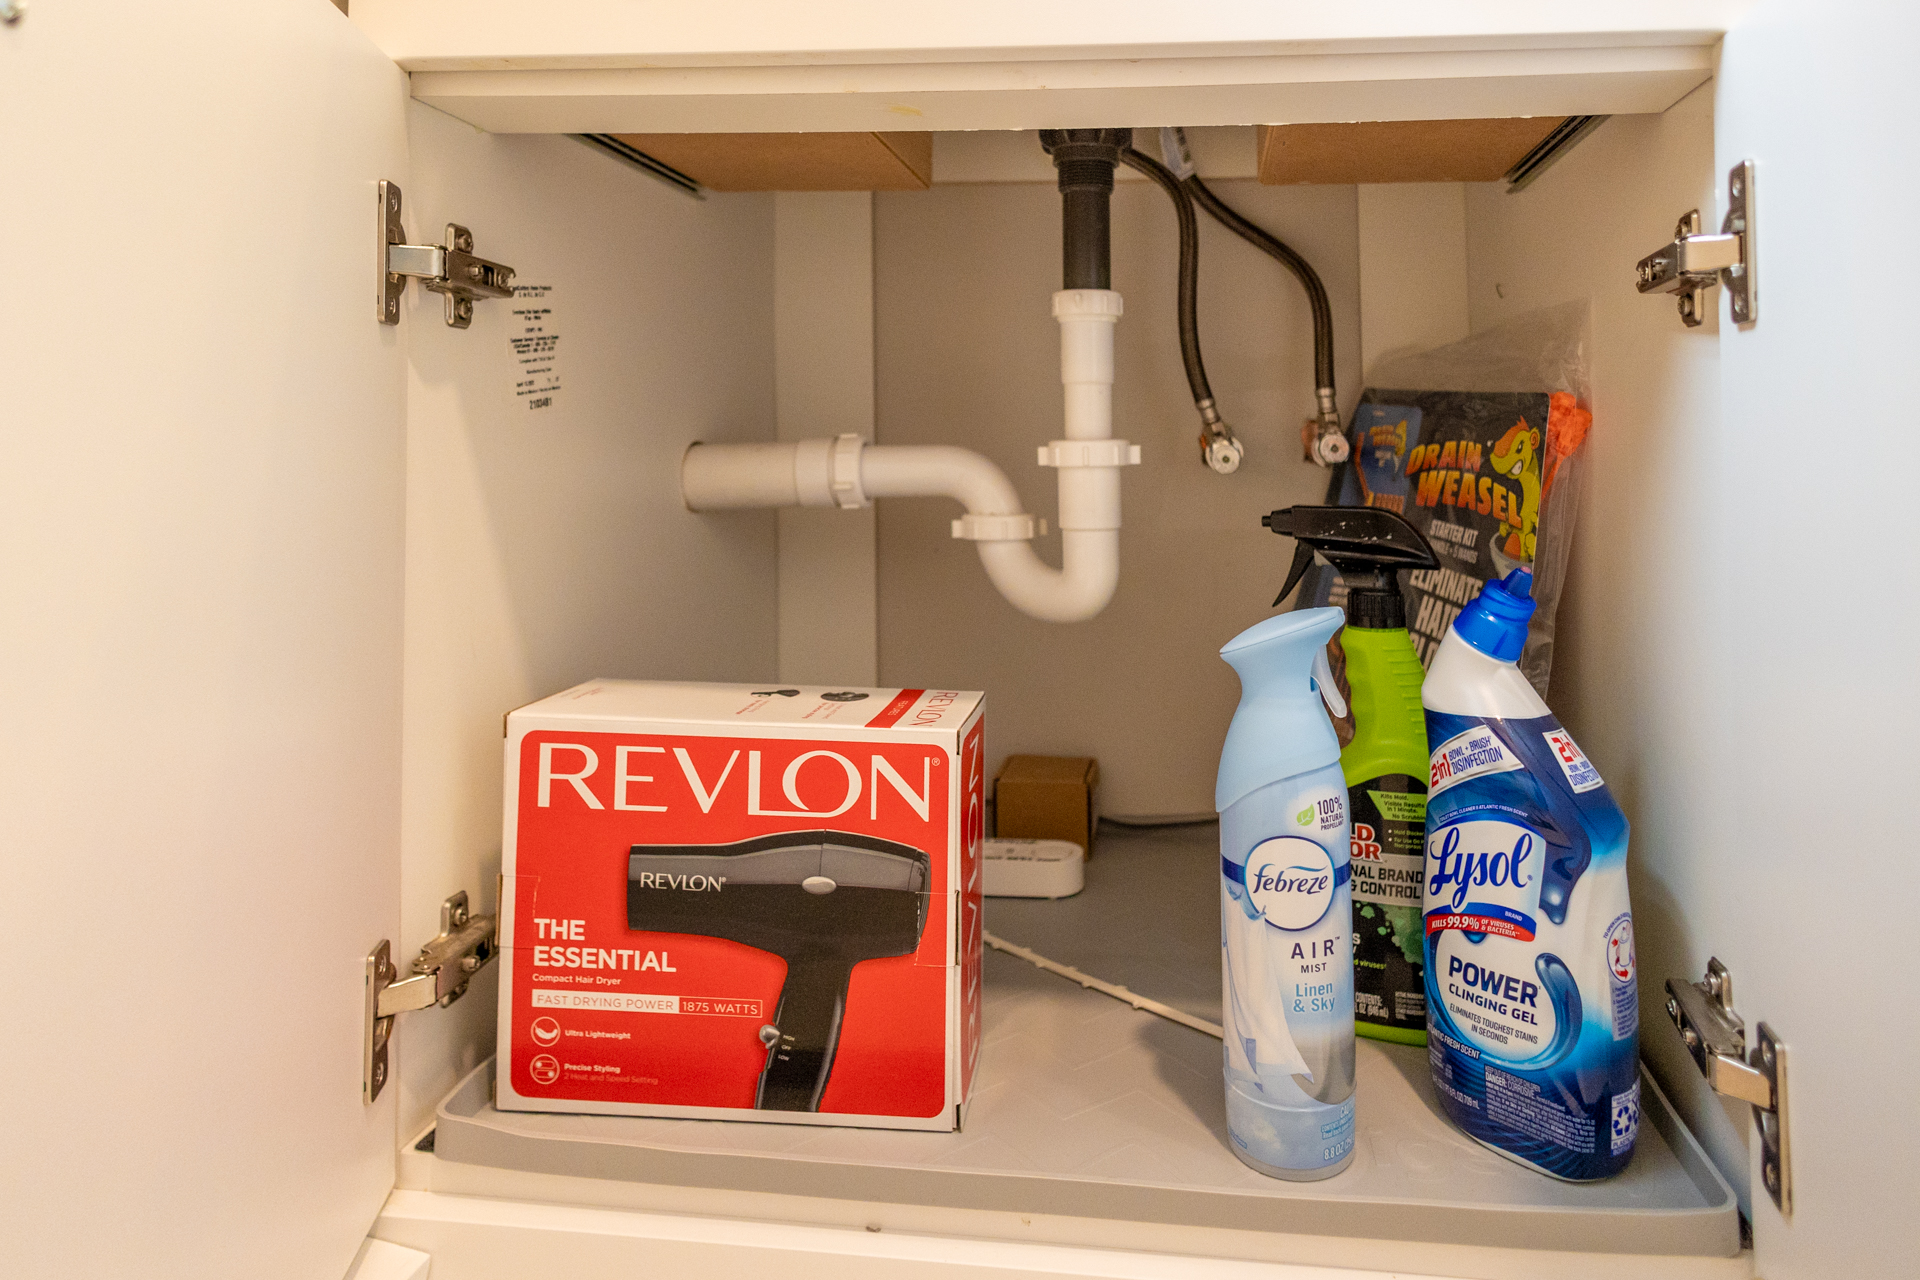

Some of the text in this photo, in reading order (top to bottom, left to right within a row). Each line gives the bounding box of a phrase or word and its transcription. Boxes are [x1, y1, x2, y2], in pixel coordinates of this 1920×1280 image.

[1404, 440, 1482, 476] DRAIN
[1416, 470, 1522, 529] WEASEL
[1429, 519, 1479, 548] STARTER KIT
[1448, 746, 1465, 762] BOWL
[1451, 746, 1504, 775] DISINFECTION
[1317, 795, 1343, 816] 100%
[1499, 804, 1513, 812] FRESH
[1513, 808, 1529, 818] SCENT
[1320, 811, 1344, 824] NATURAL
[1252, 863, 1328, 895] febreze
[1378, 867, 1424, 884] BRAND
[1360, 881, 1420, 899] CONTROL
[1431, 915, 1480, 930] KILLS 99.9%
[1504, 911, 1523, 922] BRAND
[534, 918, 586, 941] THE
[1490, 920, 1514, 931] VIRUSES
[534, 945, 677, 973] ESSENTIAL
[1300, 962, 1327, 974] MIST
[532, 973, 622, 986] Compact Hair Dryer
[1296, 983, 1333, 997] Linen
[537, 994, 674, 1011] FAST DRYING POWER
[683, 1000, 758, 1015] 1875 WATTS
[1293, 997, 1336, 1013] & Sky
[1448, 983, 1507, 1015] CLINGING
[1511, 1007, 1538, 1026] GEL
[1449, 1002, 1538, 1045] ELIMINATES TOUGHEST STAINS
[565, 1029, 631, 1040] Ultra Lightweight
[1471, 1023, 1508, 1045] IN SECONDS
[1443, 1034, 1460, 1051] FRESH
[1460, 1042, 1480, 1060] SCENT
[564, 1063, 621, 1074] Precise Styling
[1324, 1146, 1335, 1160] 8.8
